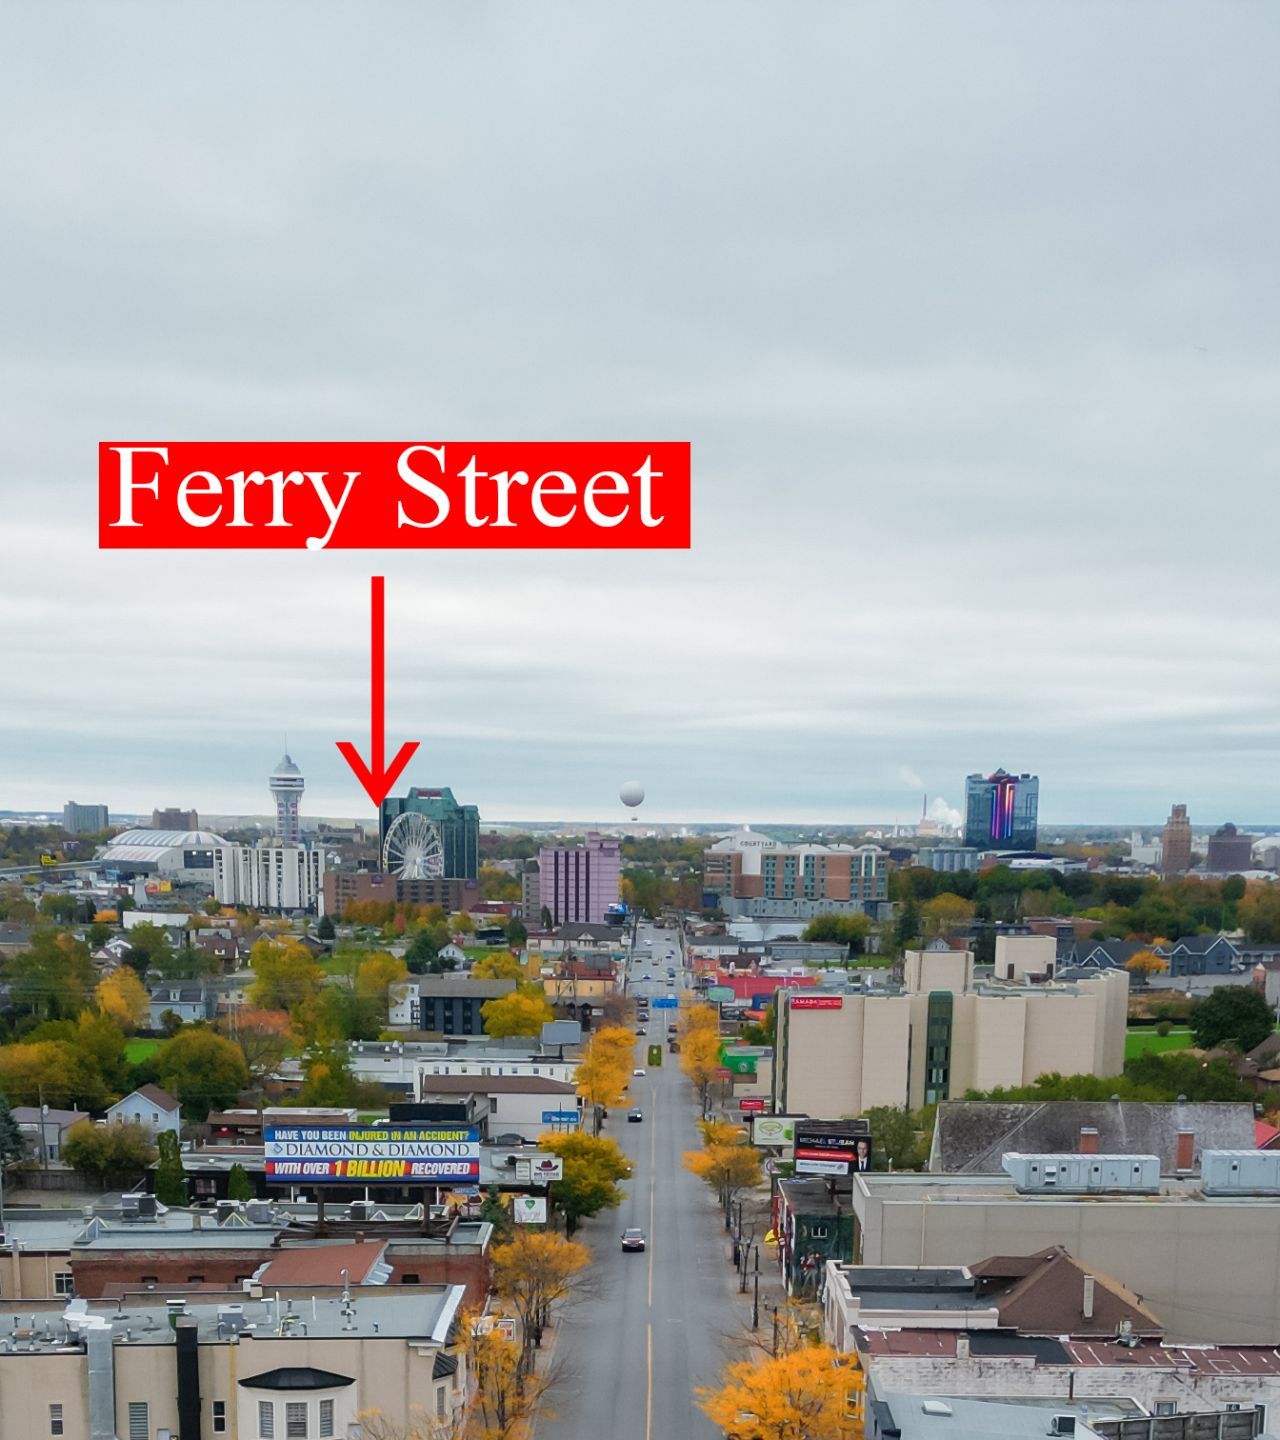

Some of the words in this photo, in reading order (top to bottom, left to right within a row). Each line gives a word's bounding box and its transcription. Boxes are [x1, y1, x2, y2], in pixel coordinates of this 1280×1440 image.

[275, 1131, 299, 1140] HAVE
[301, 1131, 320, 1140] YOU
[322, 1131, 347, 1140] BEEN
[349, 1131, 388, 1141] INJURED
[391, 1131, 402, 1141] IN
[404, 1131, 417, 1141] AN
[418, 1131, 469, 1141] ACCIDENT?
[286, 1143, 368, 1157] DIAMOND
[372, 1143, 384, 1157] &
[388, 1143, 470, 1157] DIAMOND
[274, 1163, 301, 1175] WITH
[303, 1162, 329, 1175] OVER
[335, 1161, 342, 1176] 1
[346, 1160, 406, 1177] BILLION
[410, 1162, 470, 1175] RECOVERED
